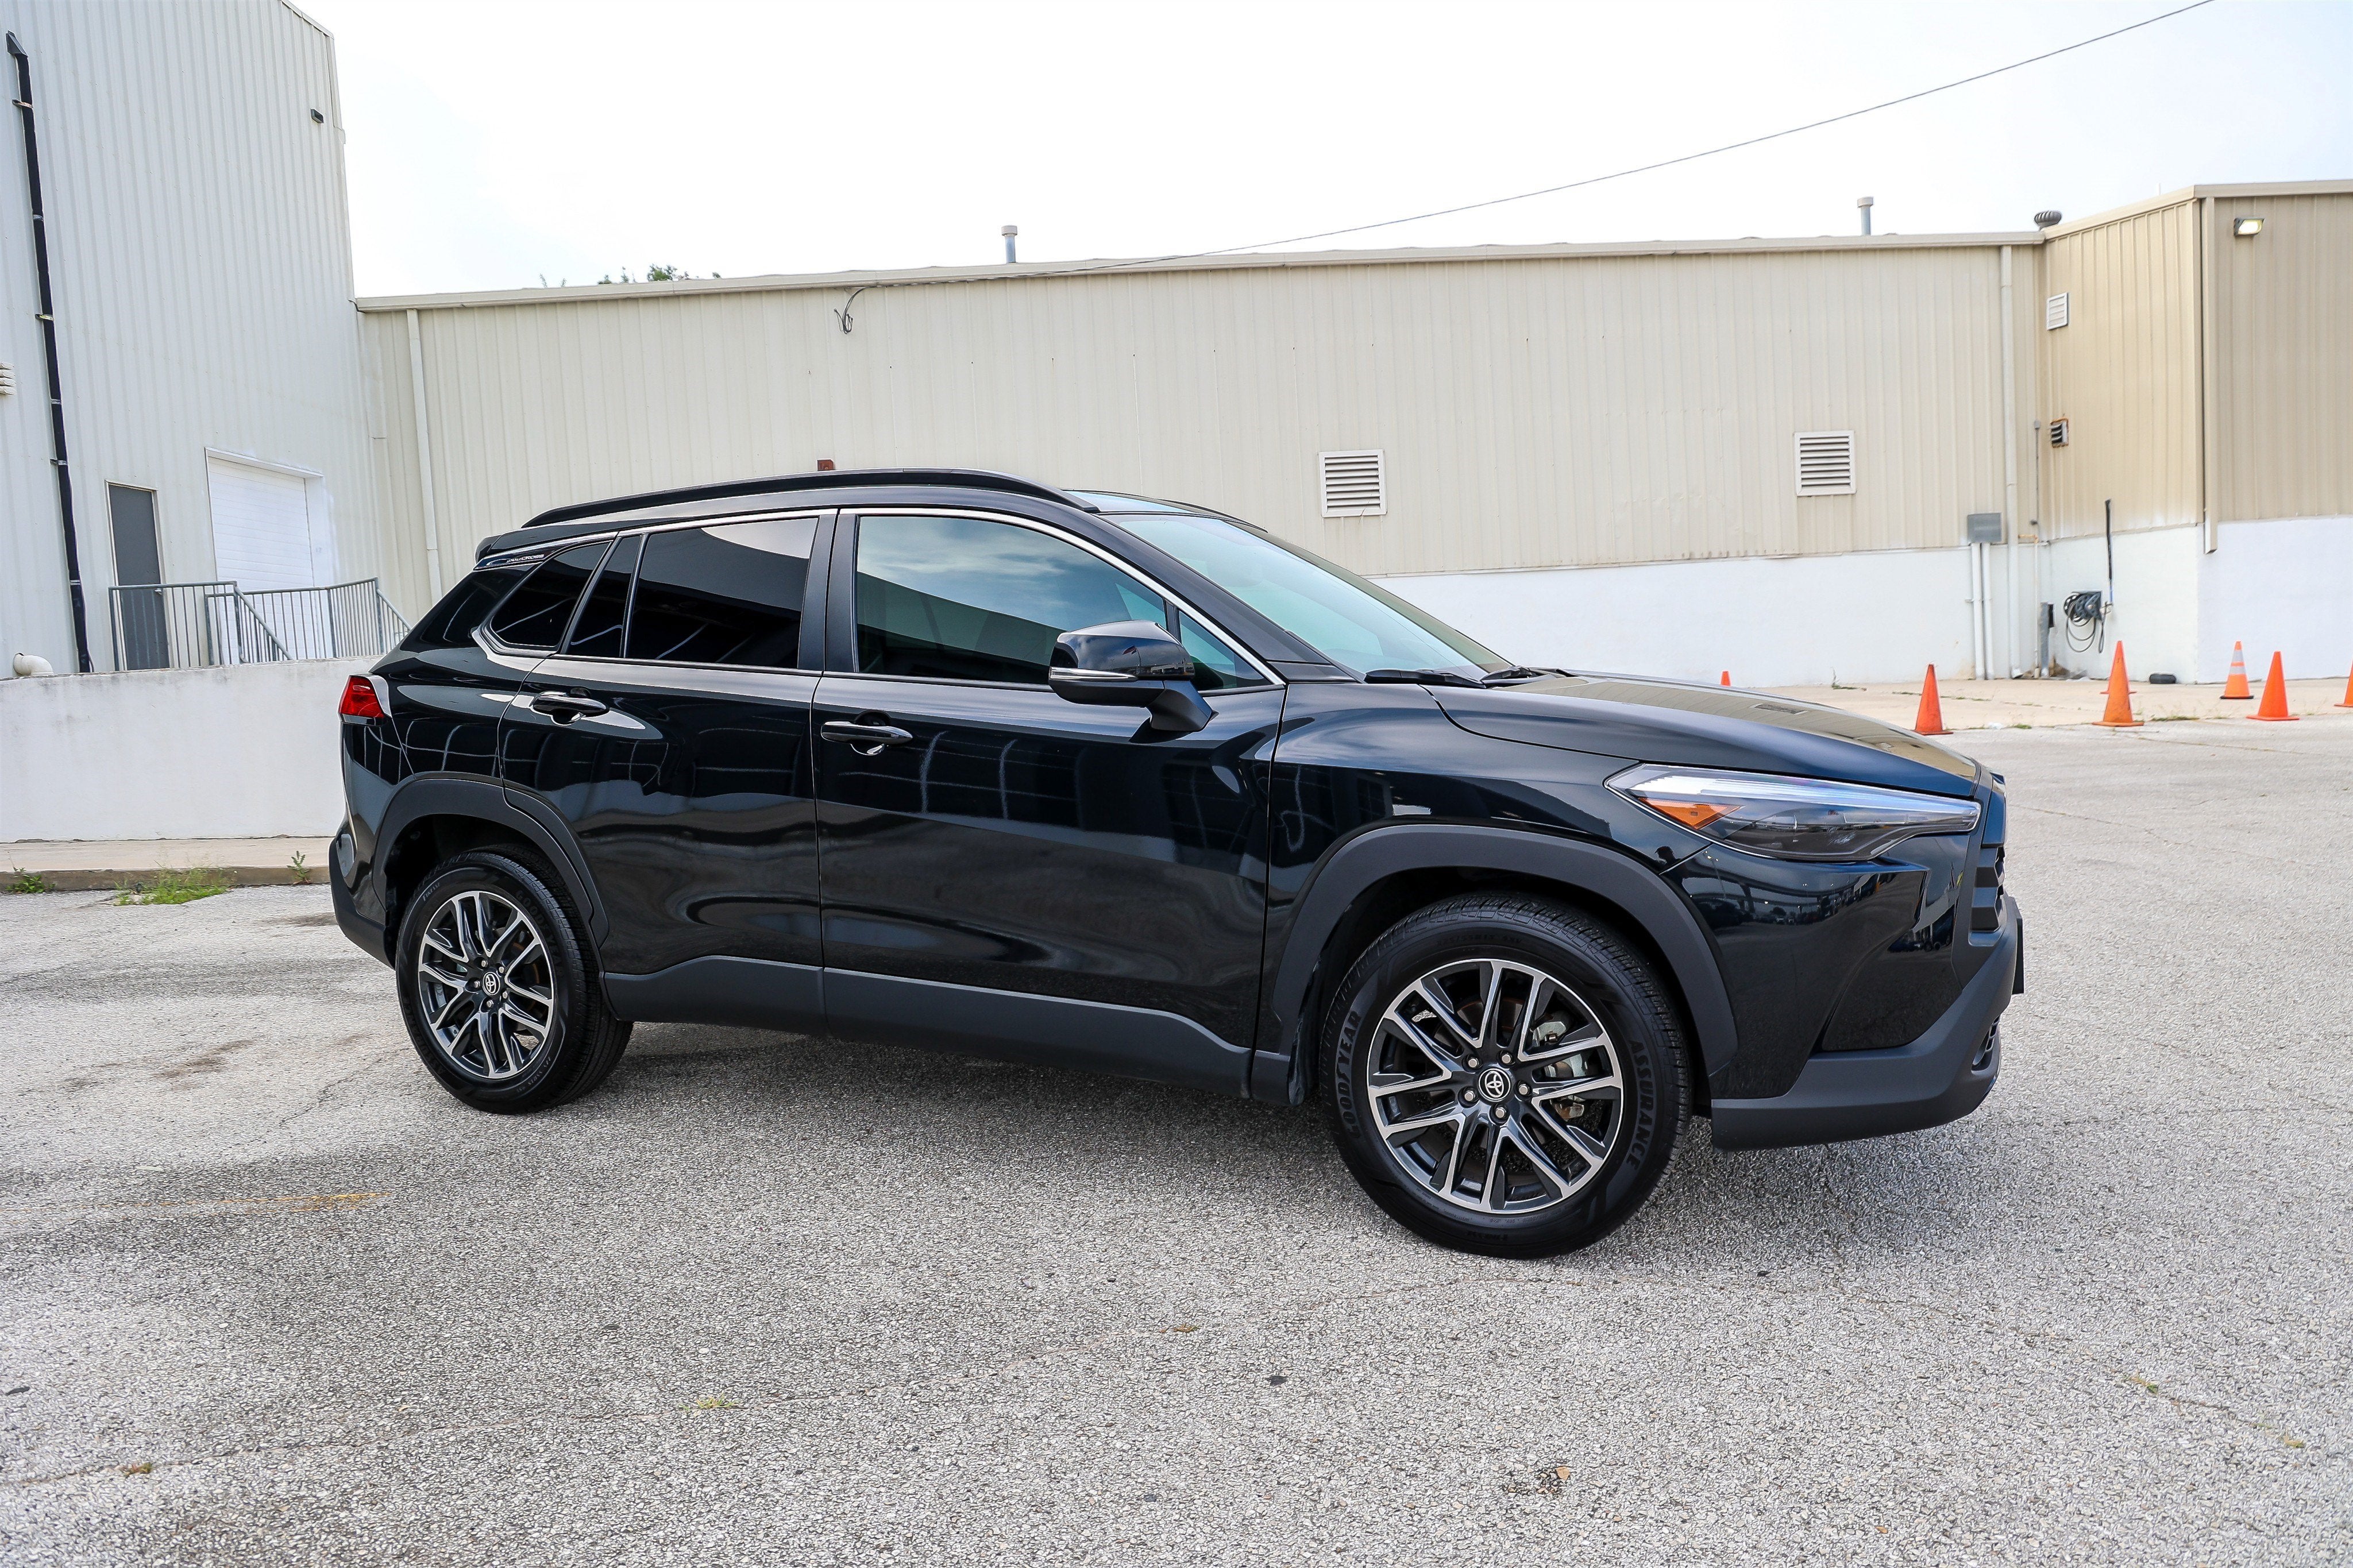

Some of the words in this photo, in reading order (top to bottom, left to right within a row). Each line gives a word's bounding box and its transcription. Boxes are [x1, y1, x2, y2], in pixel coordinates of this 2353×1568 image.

[515, 890, 565, 979] GOODYEAR
[1336, 1010, 1361, 1139] GOODYEAR
[1626, 1040, 1654, 1171] ASSURANCE
